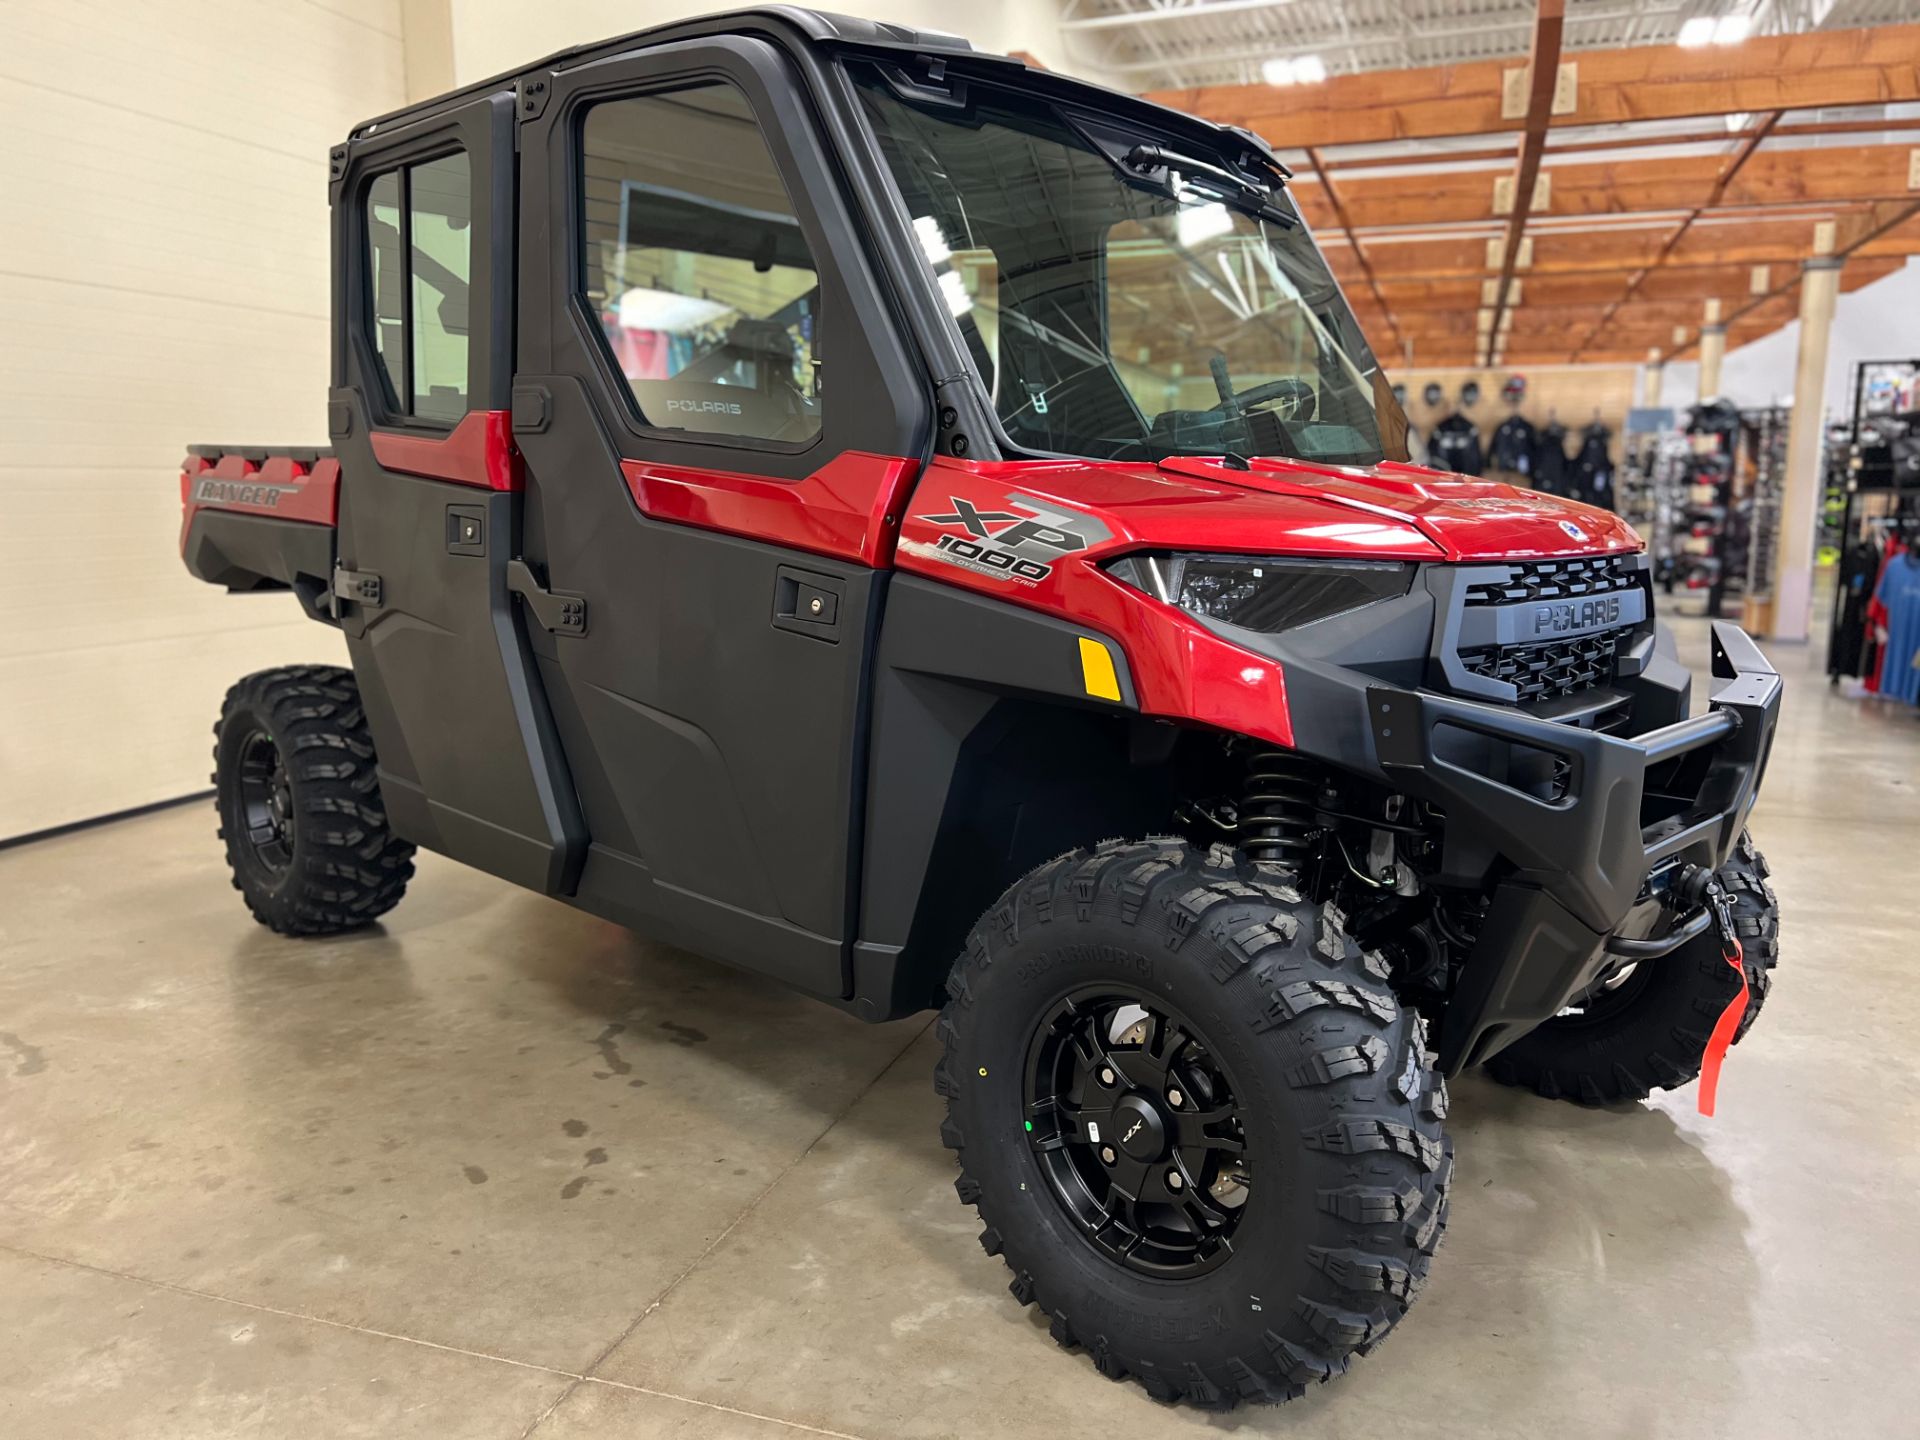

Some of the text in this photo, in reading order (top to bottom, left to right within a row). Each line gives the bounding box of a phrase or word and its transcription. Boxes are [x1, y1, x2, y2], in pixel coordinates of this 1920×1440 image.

[666, 400, 742, 415] POLARIS
[200, 481, 281, 507] RANGER
[913, 496, 1088, 552] XP
[936, 533, 1053, 582] 1000
[1012, 577, 1038, 589] CAM
[1534, 598, 1619, 634] POLARIS
[1122, 1119, 1142, 1143] XP
